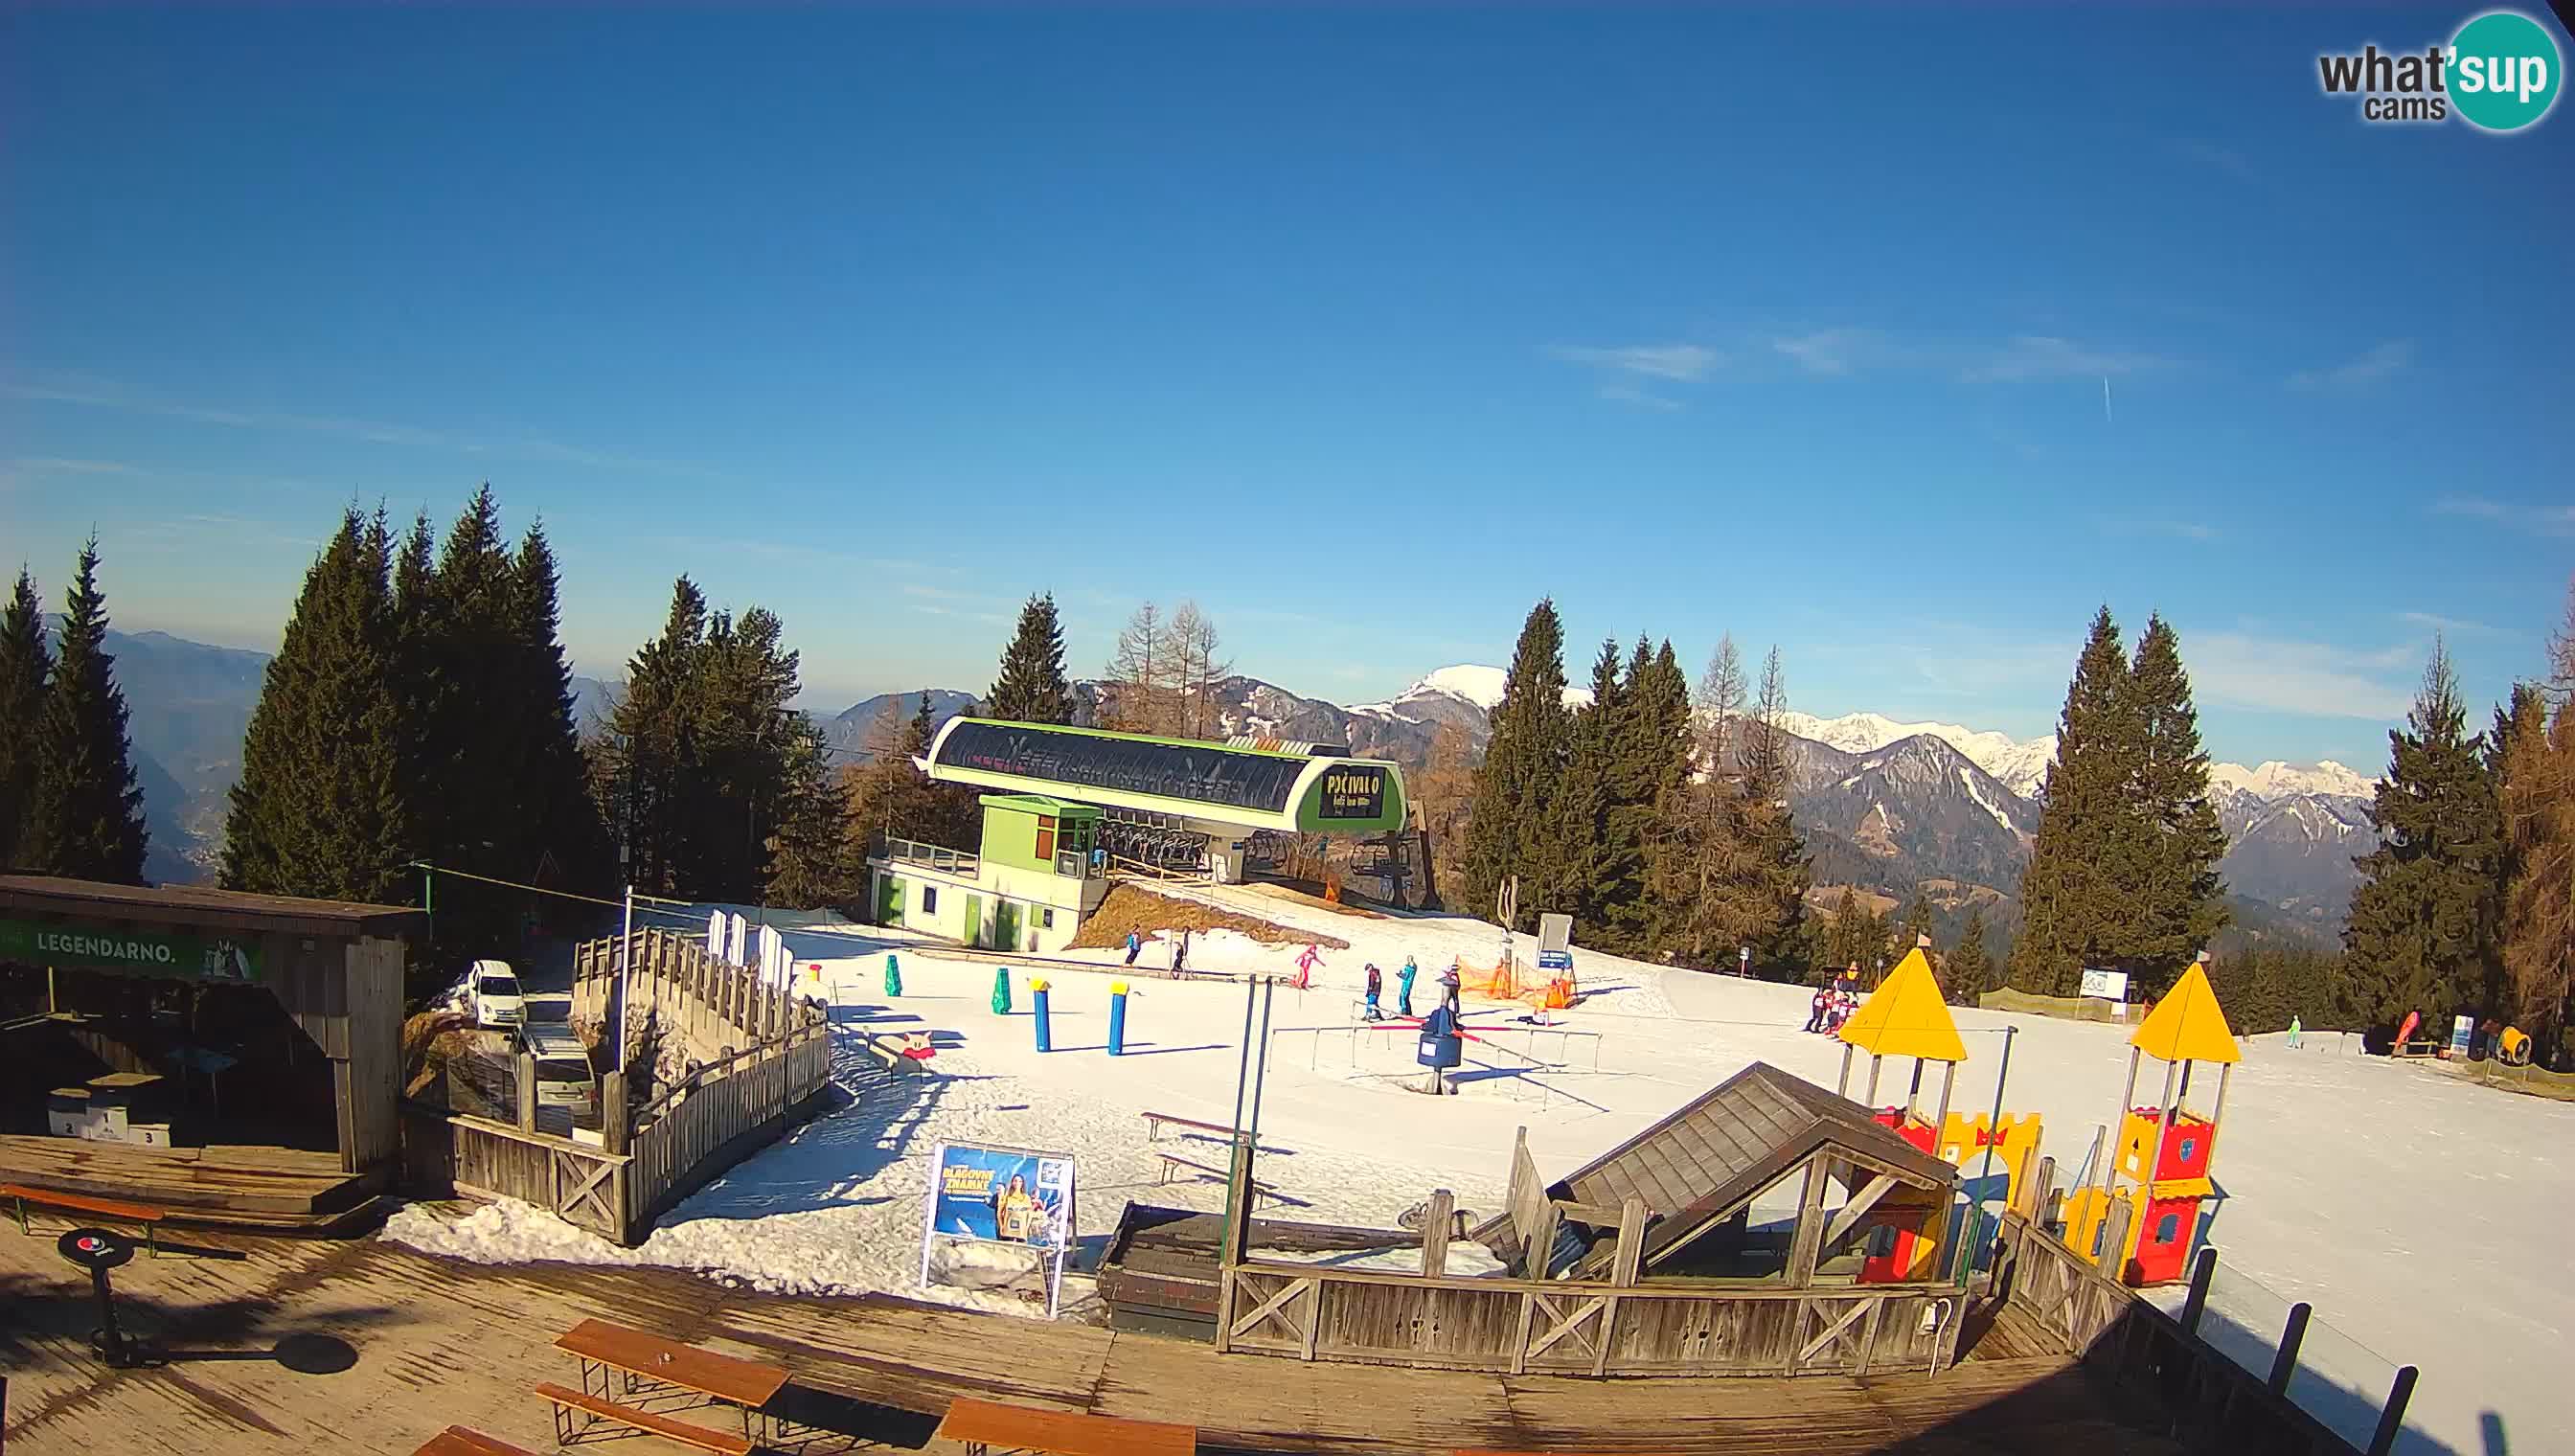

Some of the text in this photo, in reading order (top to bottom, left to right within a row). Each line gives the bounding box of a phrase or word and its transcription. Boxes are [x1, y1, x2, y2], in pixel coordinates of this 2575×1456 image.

[37, 932, 176, 964] LEGENDARNO.
[65, 1123, 74, 1134] 2
[145, 1132, 153, 1144] 3
